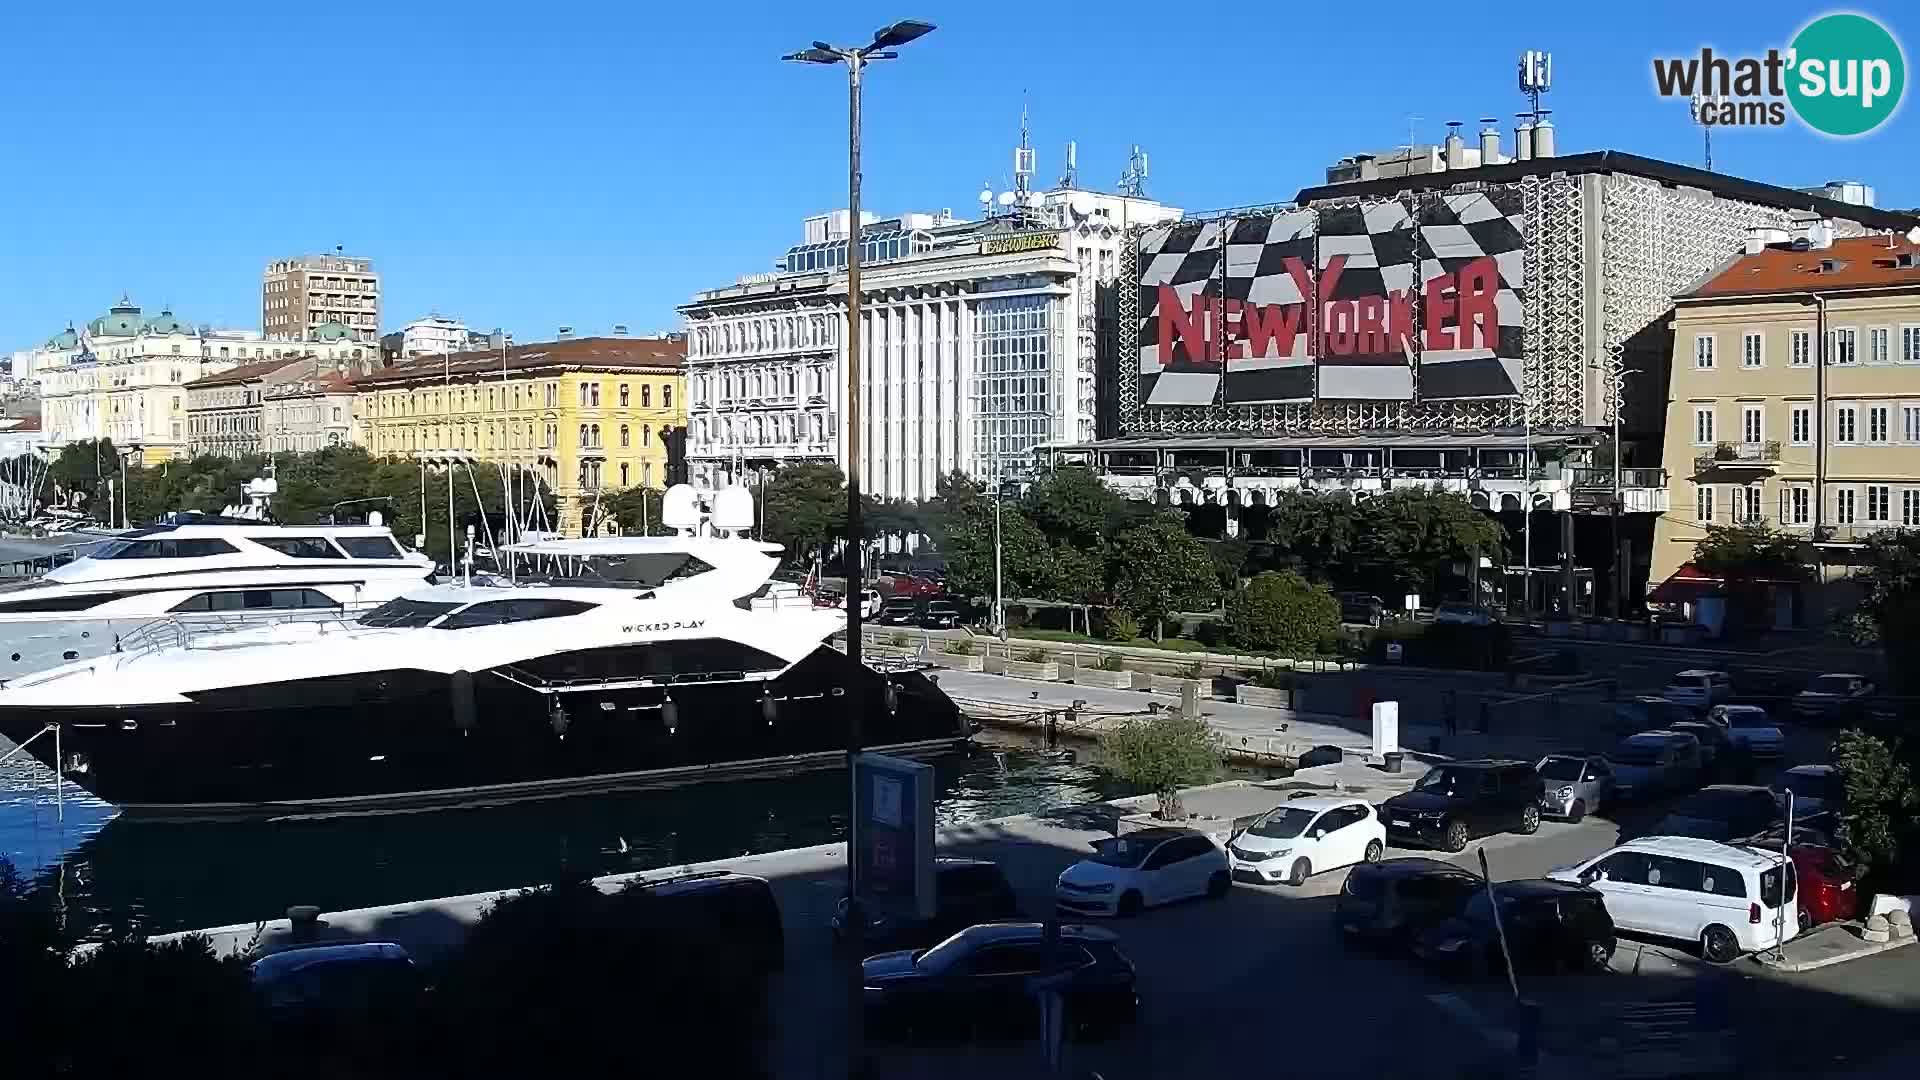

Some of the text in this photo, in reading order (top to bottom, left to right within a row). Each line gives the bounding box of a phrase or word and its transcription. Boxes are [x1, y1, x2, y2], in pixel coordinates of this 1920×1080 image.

[1158, 254, 1501, 364] NEW YORKER
[621, 619, 705, 633] WICKED PLAY
